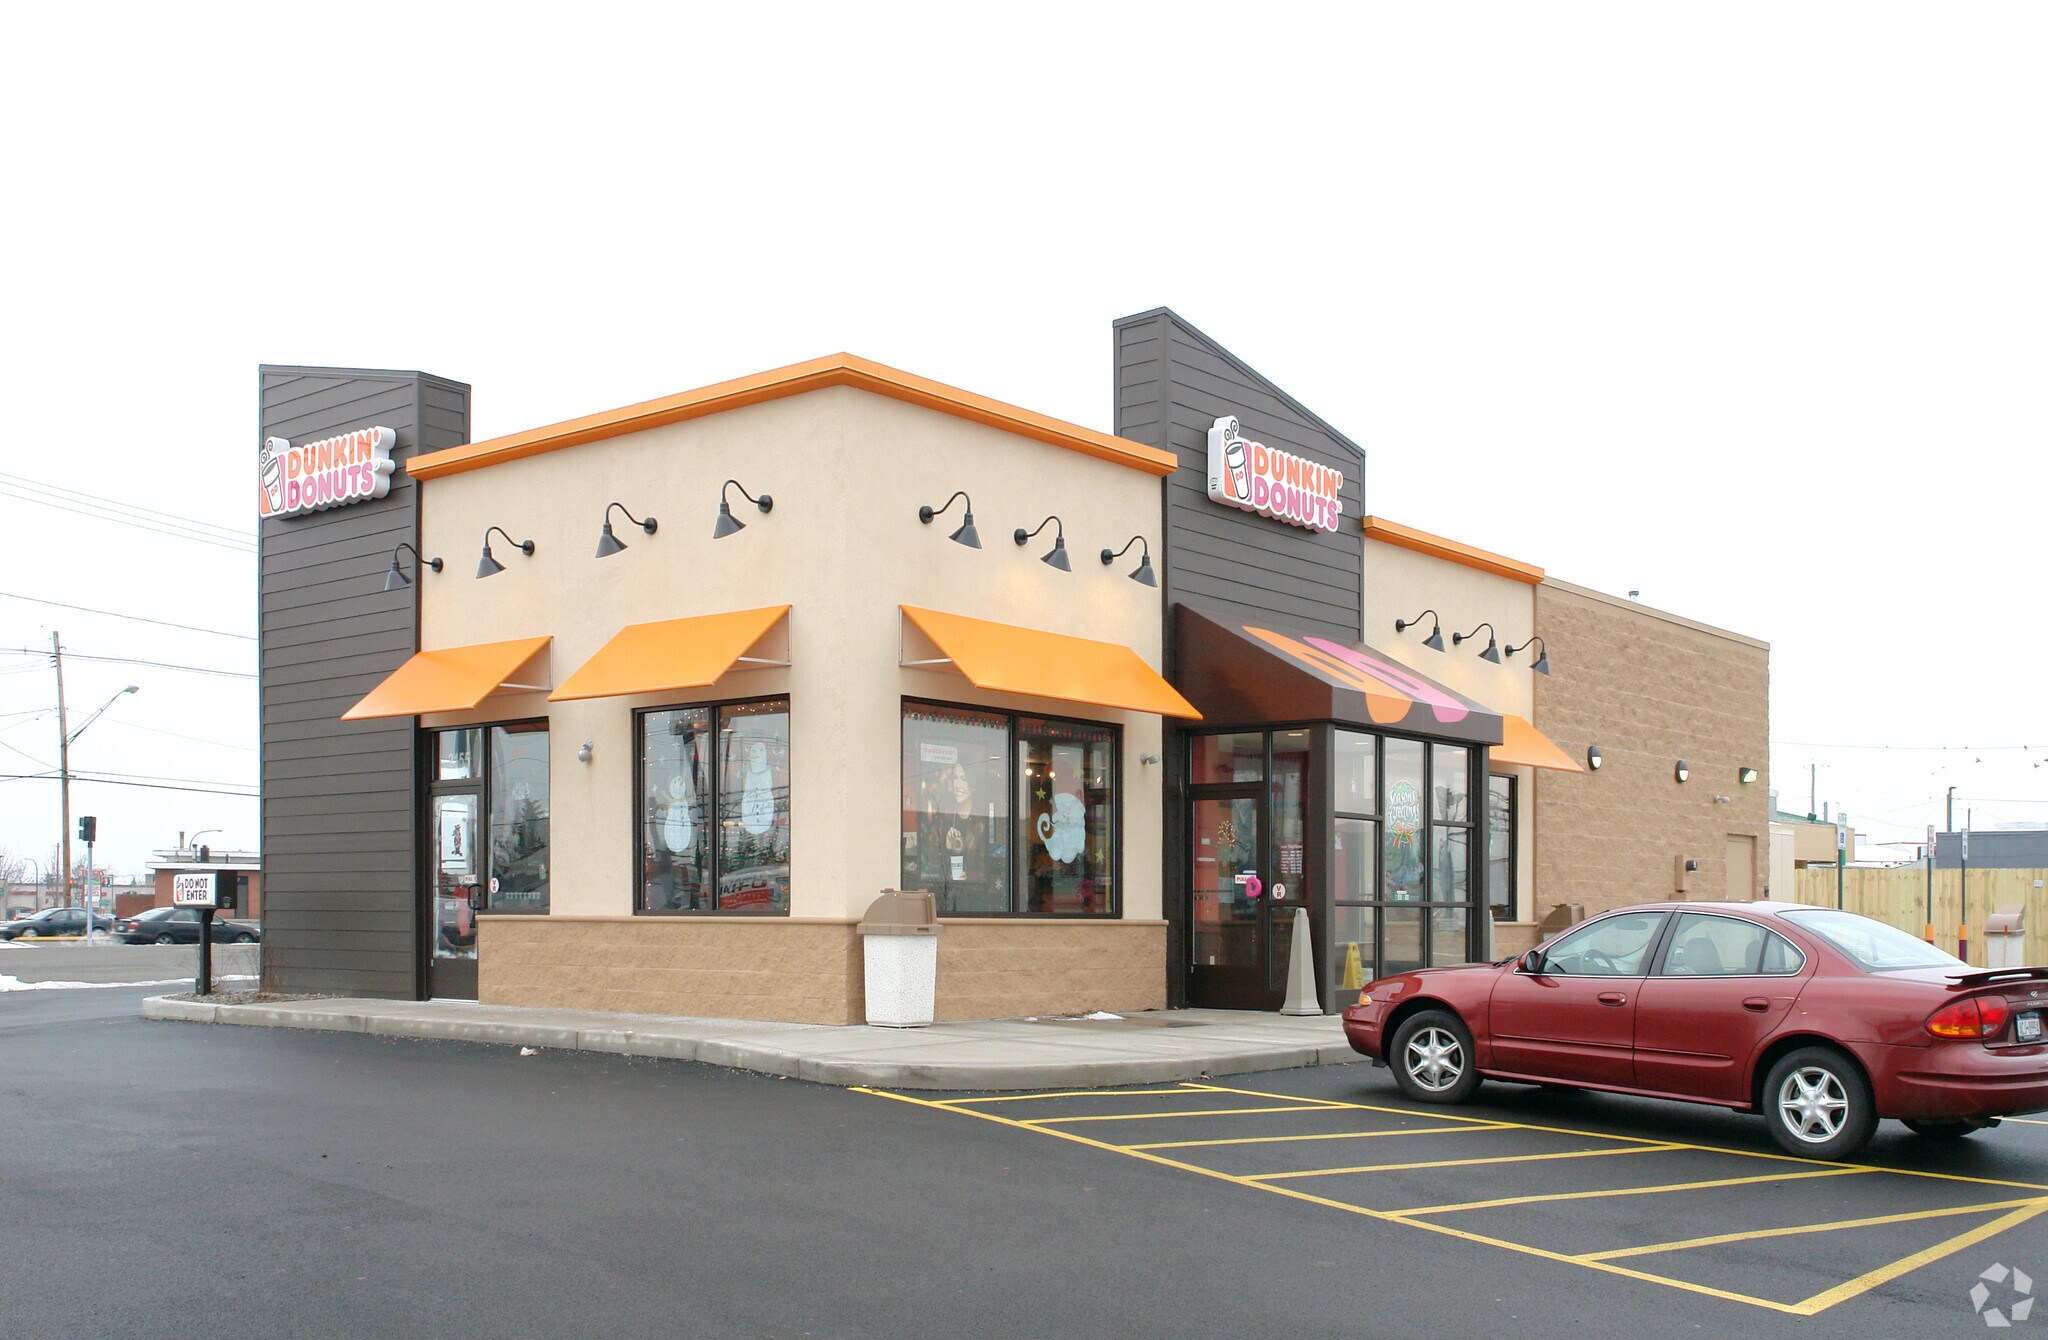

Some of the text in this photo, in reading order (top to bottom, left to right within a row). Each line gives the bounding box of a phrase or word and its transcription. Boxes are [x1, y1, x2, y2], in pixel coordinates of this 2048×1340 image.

[288, 429, 380, 480] DUNKIN'
[1254, 445, 1343, 500] DUNKIN'
[288, 461, 374, 510] DONUTS
[1254, 476, 1339, 530] DONUTS
[184, 878, 208, 889] DO NOT
[186, 890, 208, 901] ENTER
